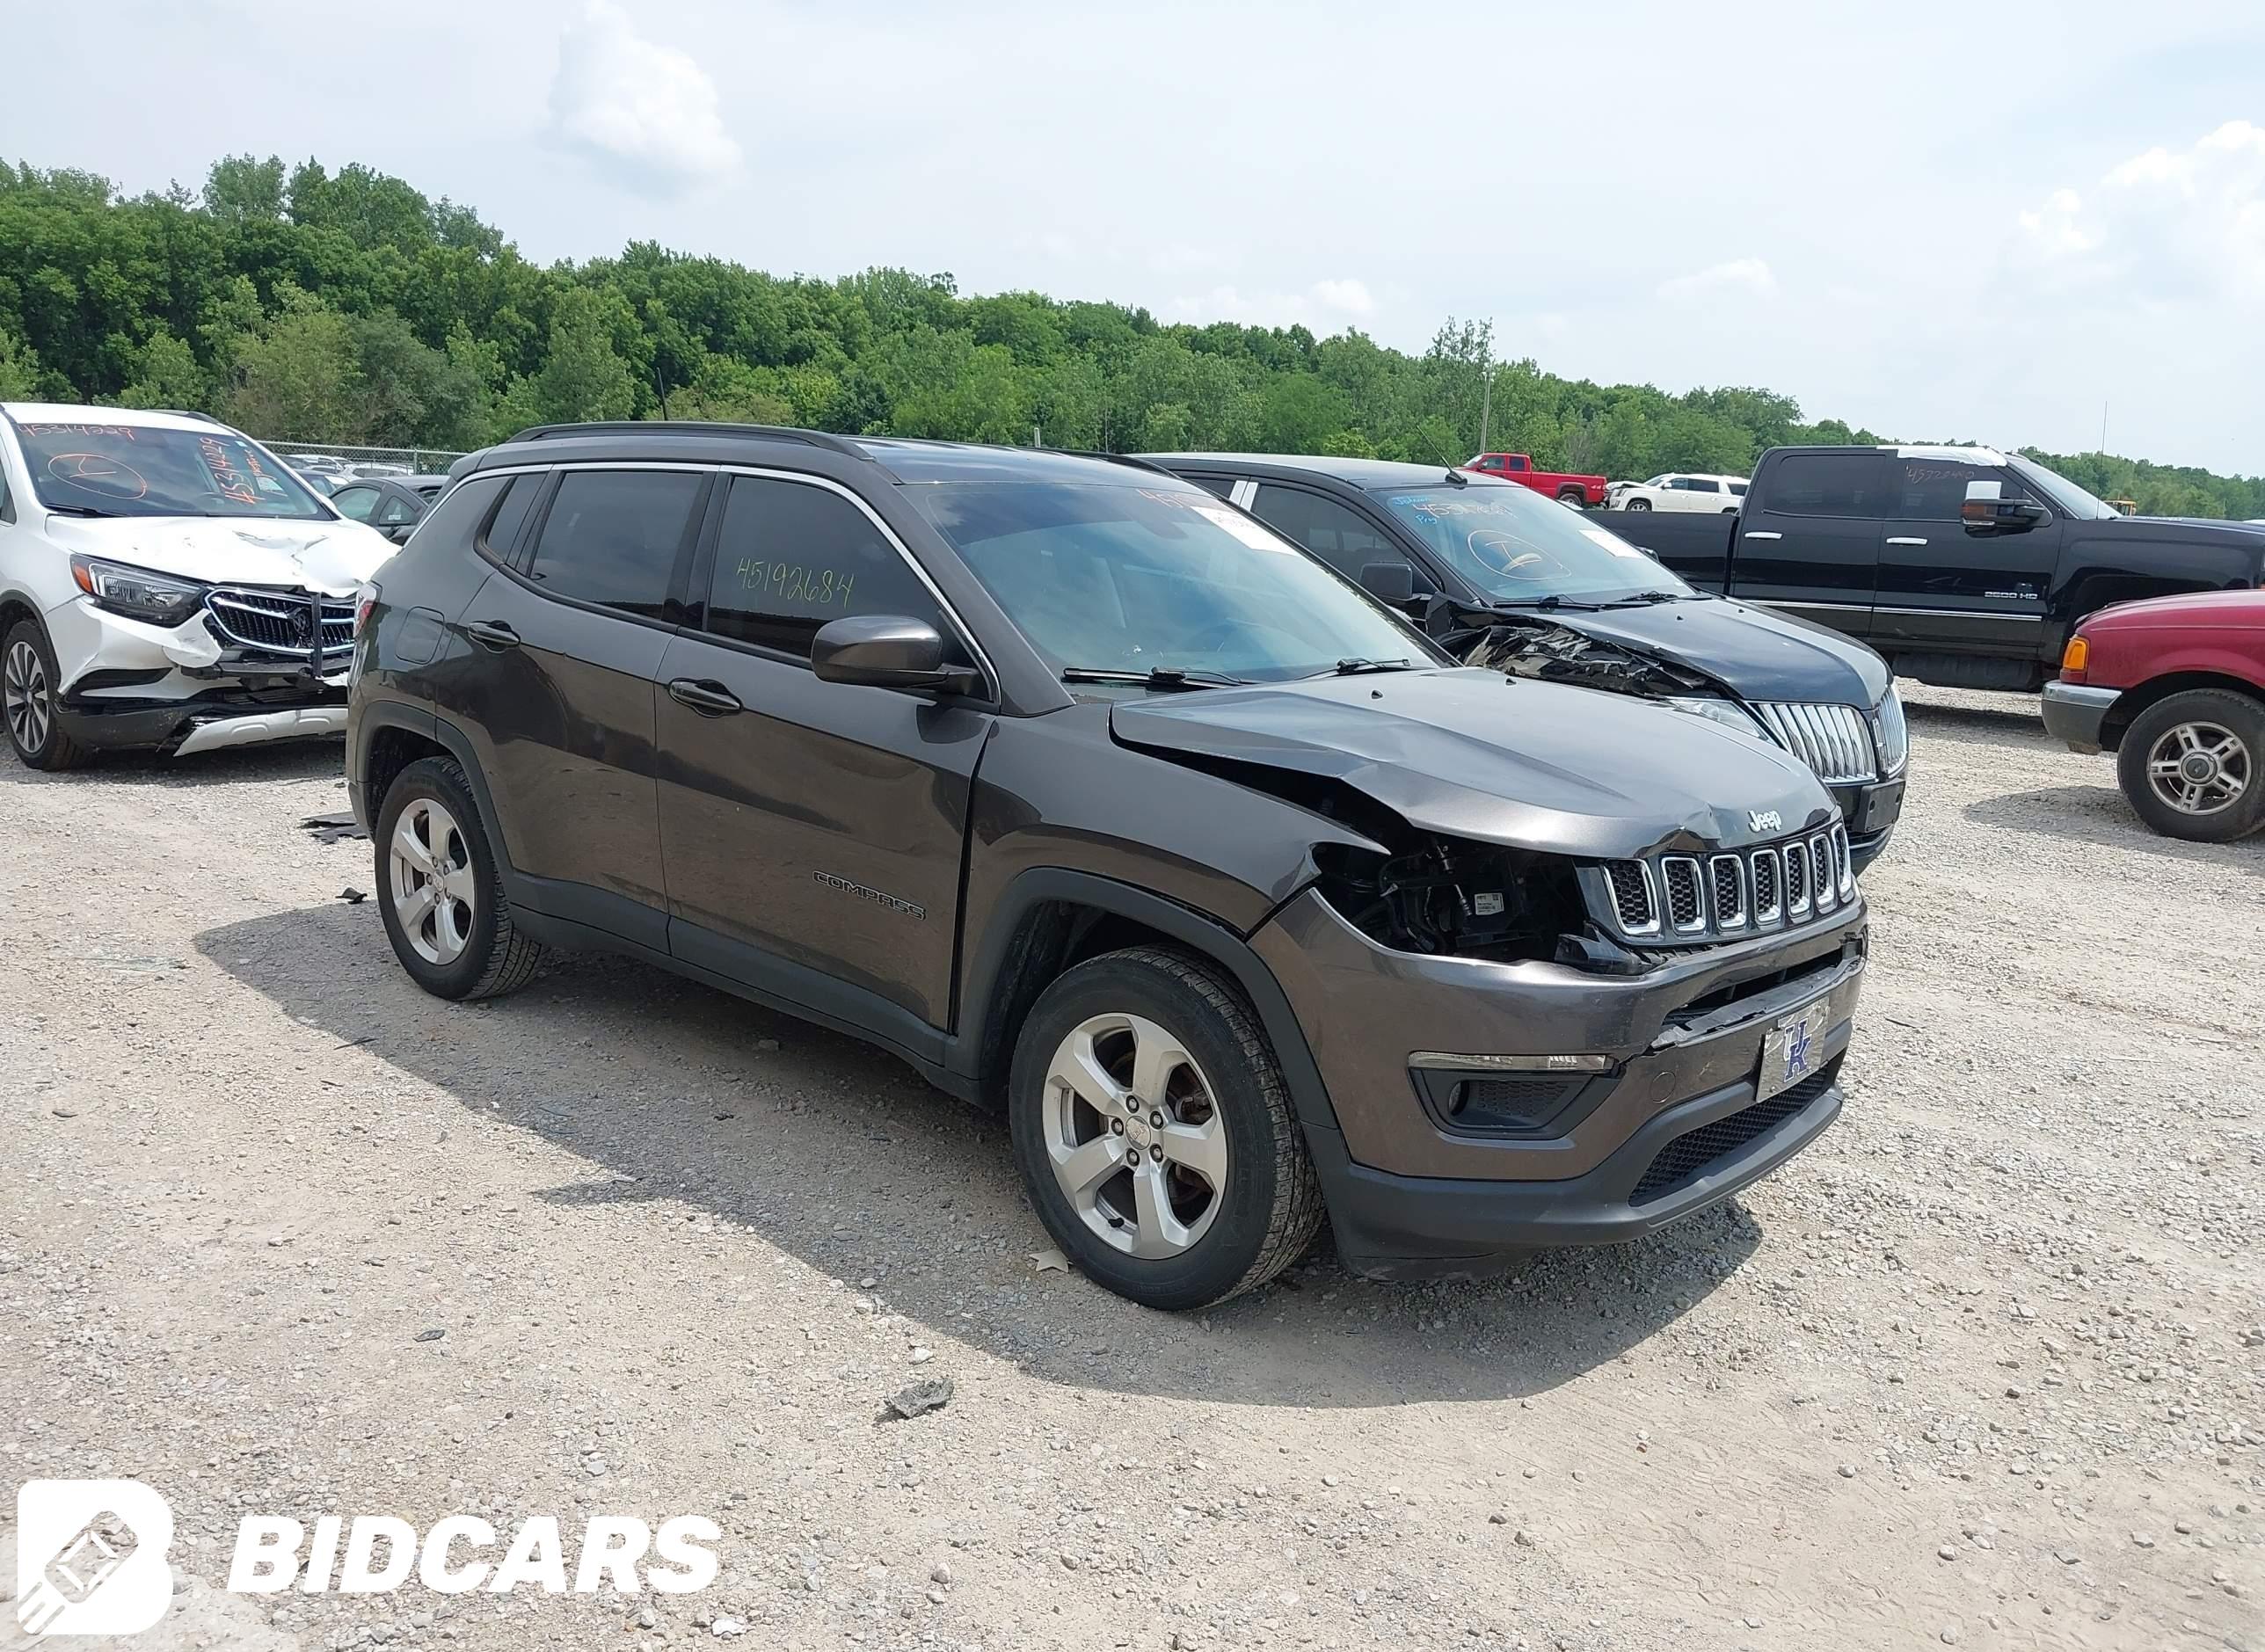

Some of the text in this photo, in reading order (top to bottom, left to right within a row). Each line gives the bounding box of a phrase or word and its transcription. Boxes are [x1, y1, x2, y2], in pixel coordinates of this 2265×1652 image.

[736, 556, 855, 608] 45192684
[1747, 810, 1782, 833] Jeep
[812, 870, 927, 921] COMPASS
